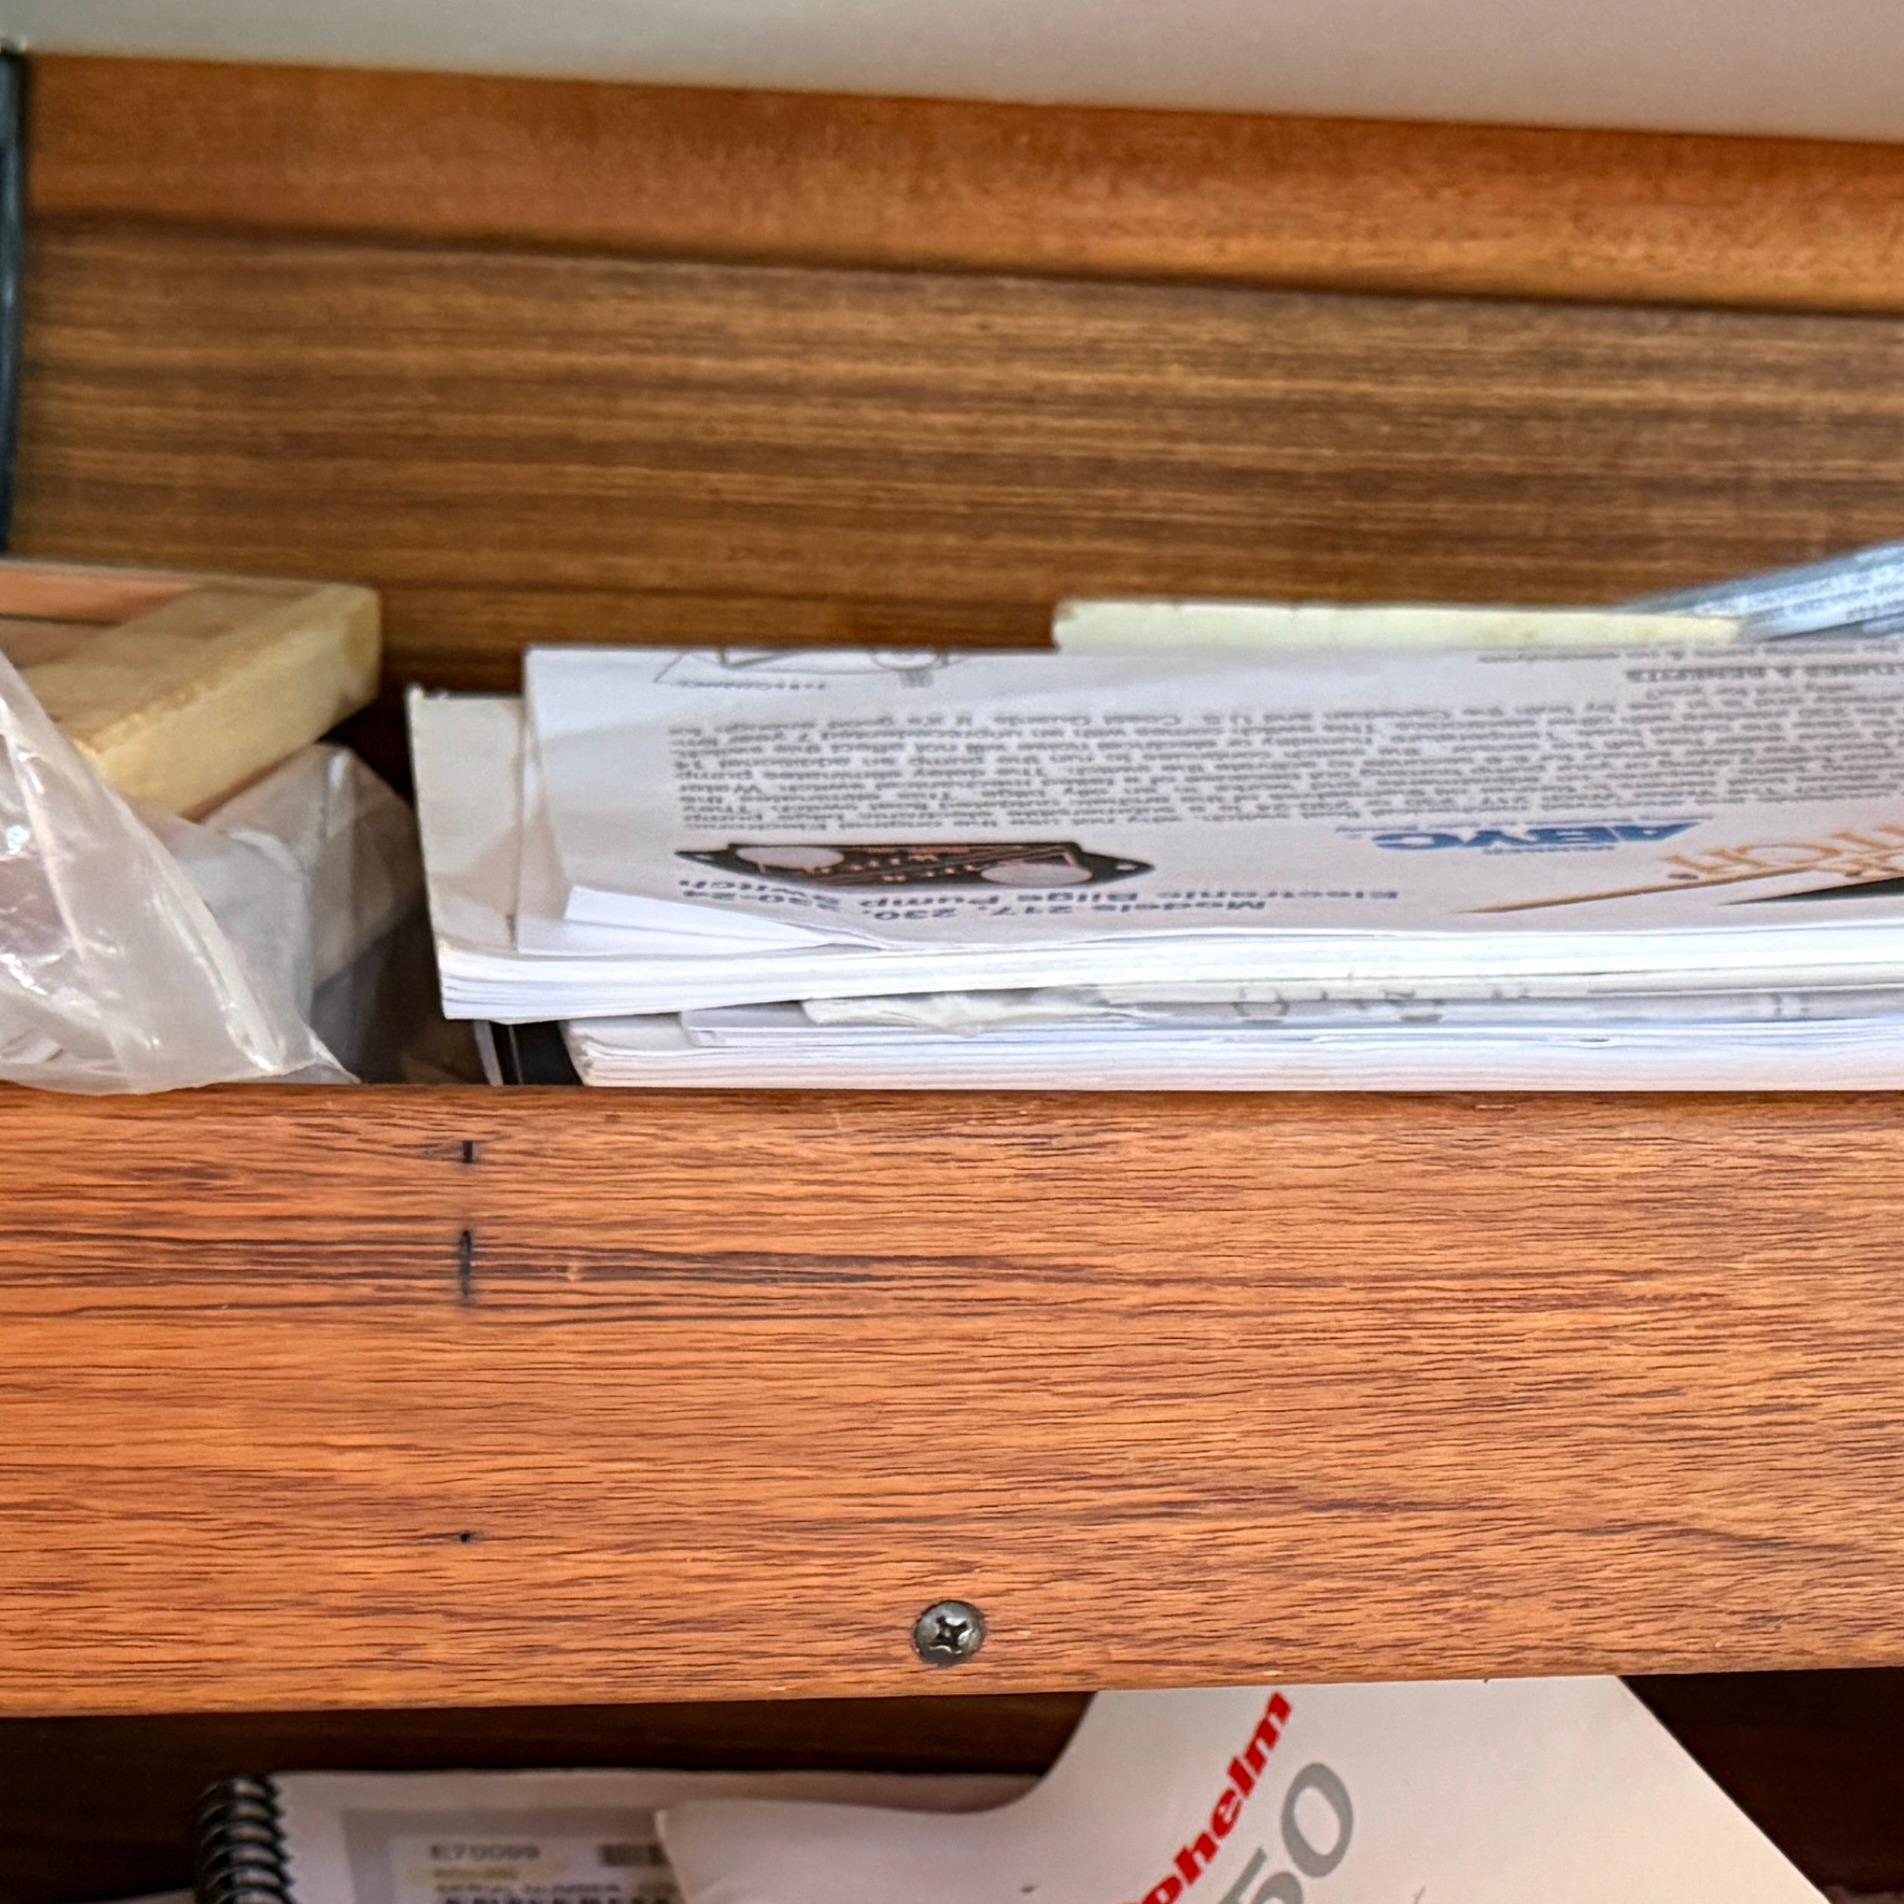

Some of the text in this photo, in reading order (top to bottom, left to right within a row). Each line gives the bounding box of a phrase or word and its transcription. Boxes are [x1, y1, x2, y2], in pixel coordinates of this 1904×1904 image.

[1372, 822, 1701, 851] ABYC
[679, 880, 1398, 908] Electronic Bilge Pump Switch
[1092, 901, 1265, 913] Models
